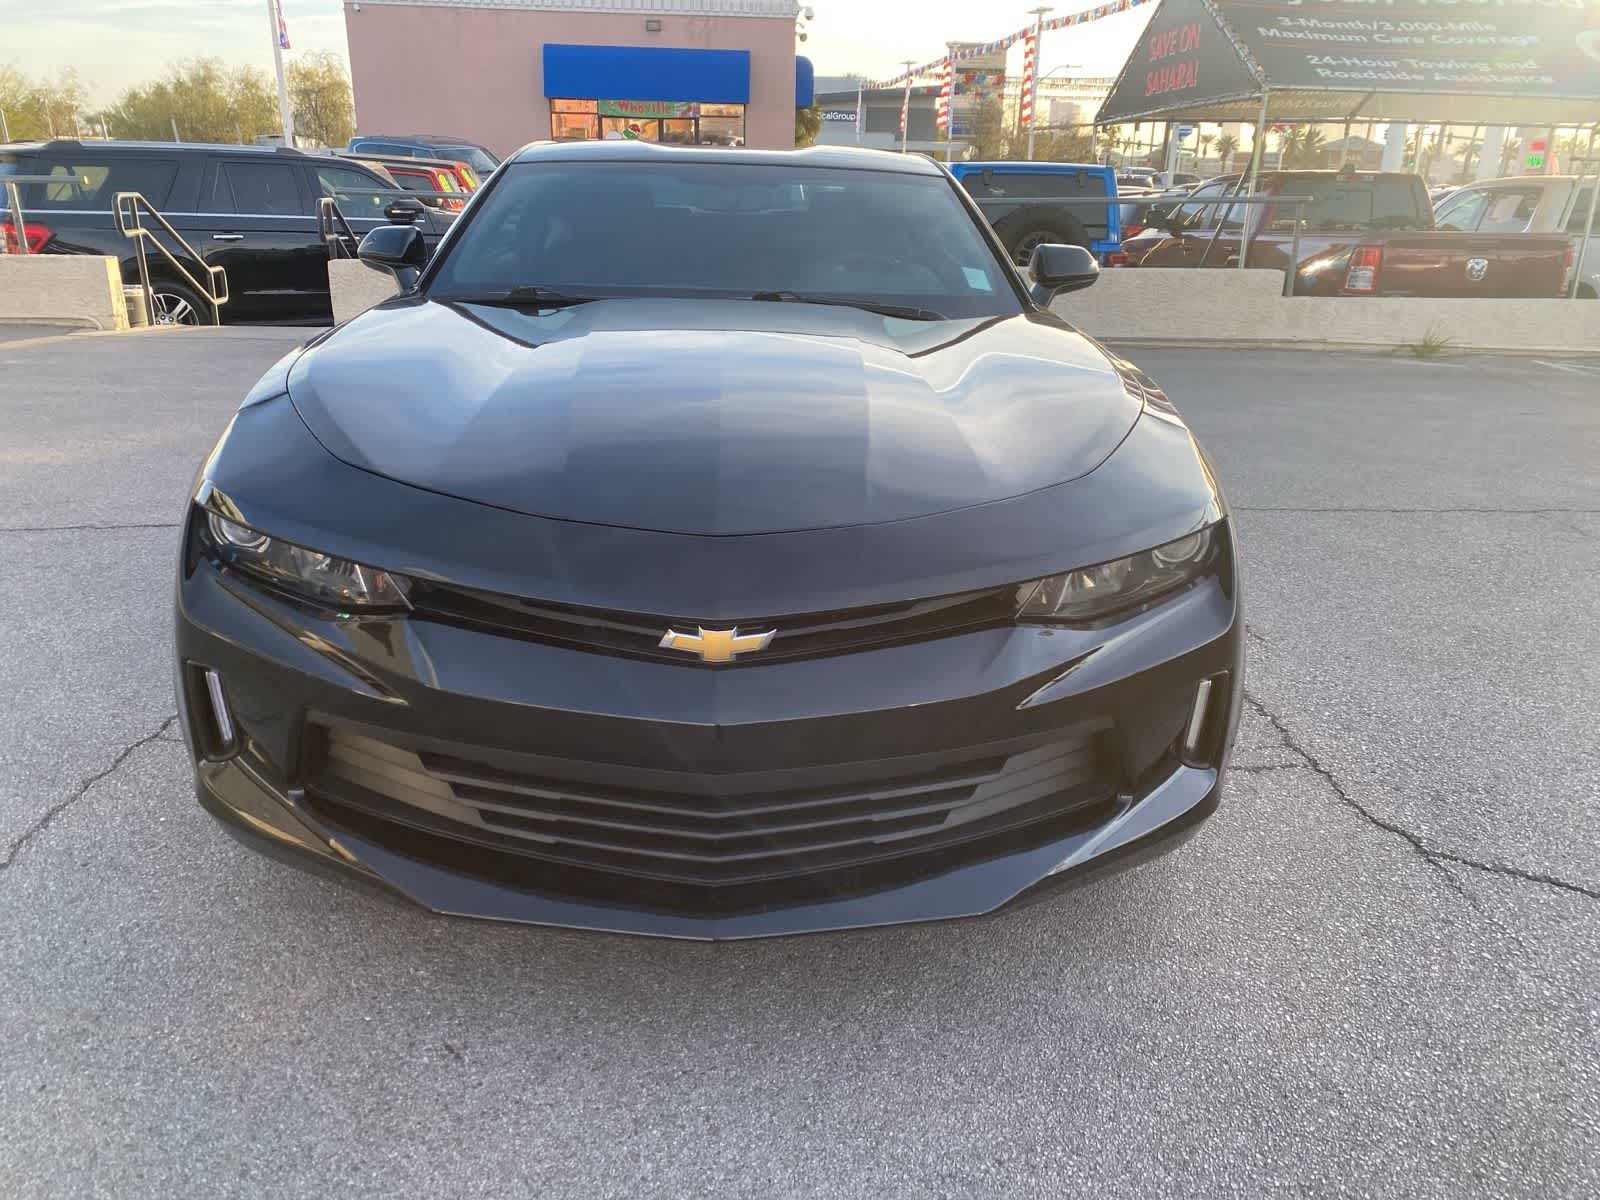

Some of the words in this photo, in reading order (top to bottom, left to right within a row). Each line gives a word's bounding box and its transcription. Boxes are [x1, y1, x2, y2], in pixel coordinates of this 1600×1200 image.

[1149, 29, 1179, 62] SAVE
[1180, 23, 1201, 53] ON
[1257, 27, 1368, 43] Maximum
[1306, 55, 1398, 68] 24-Hour
[1402, 58, 1490, 72] Towing
[1496, 59, 1538, 70] and
[1144, 60, 1199, 97] SAHARA!
[1315, 67, 1425, 81] Roadside
